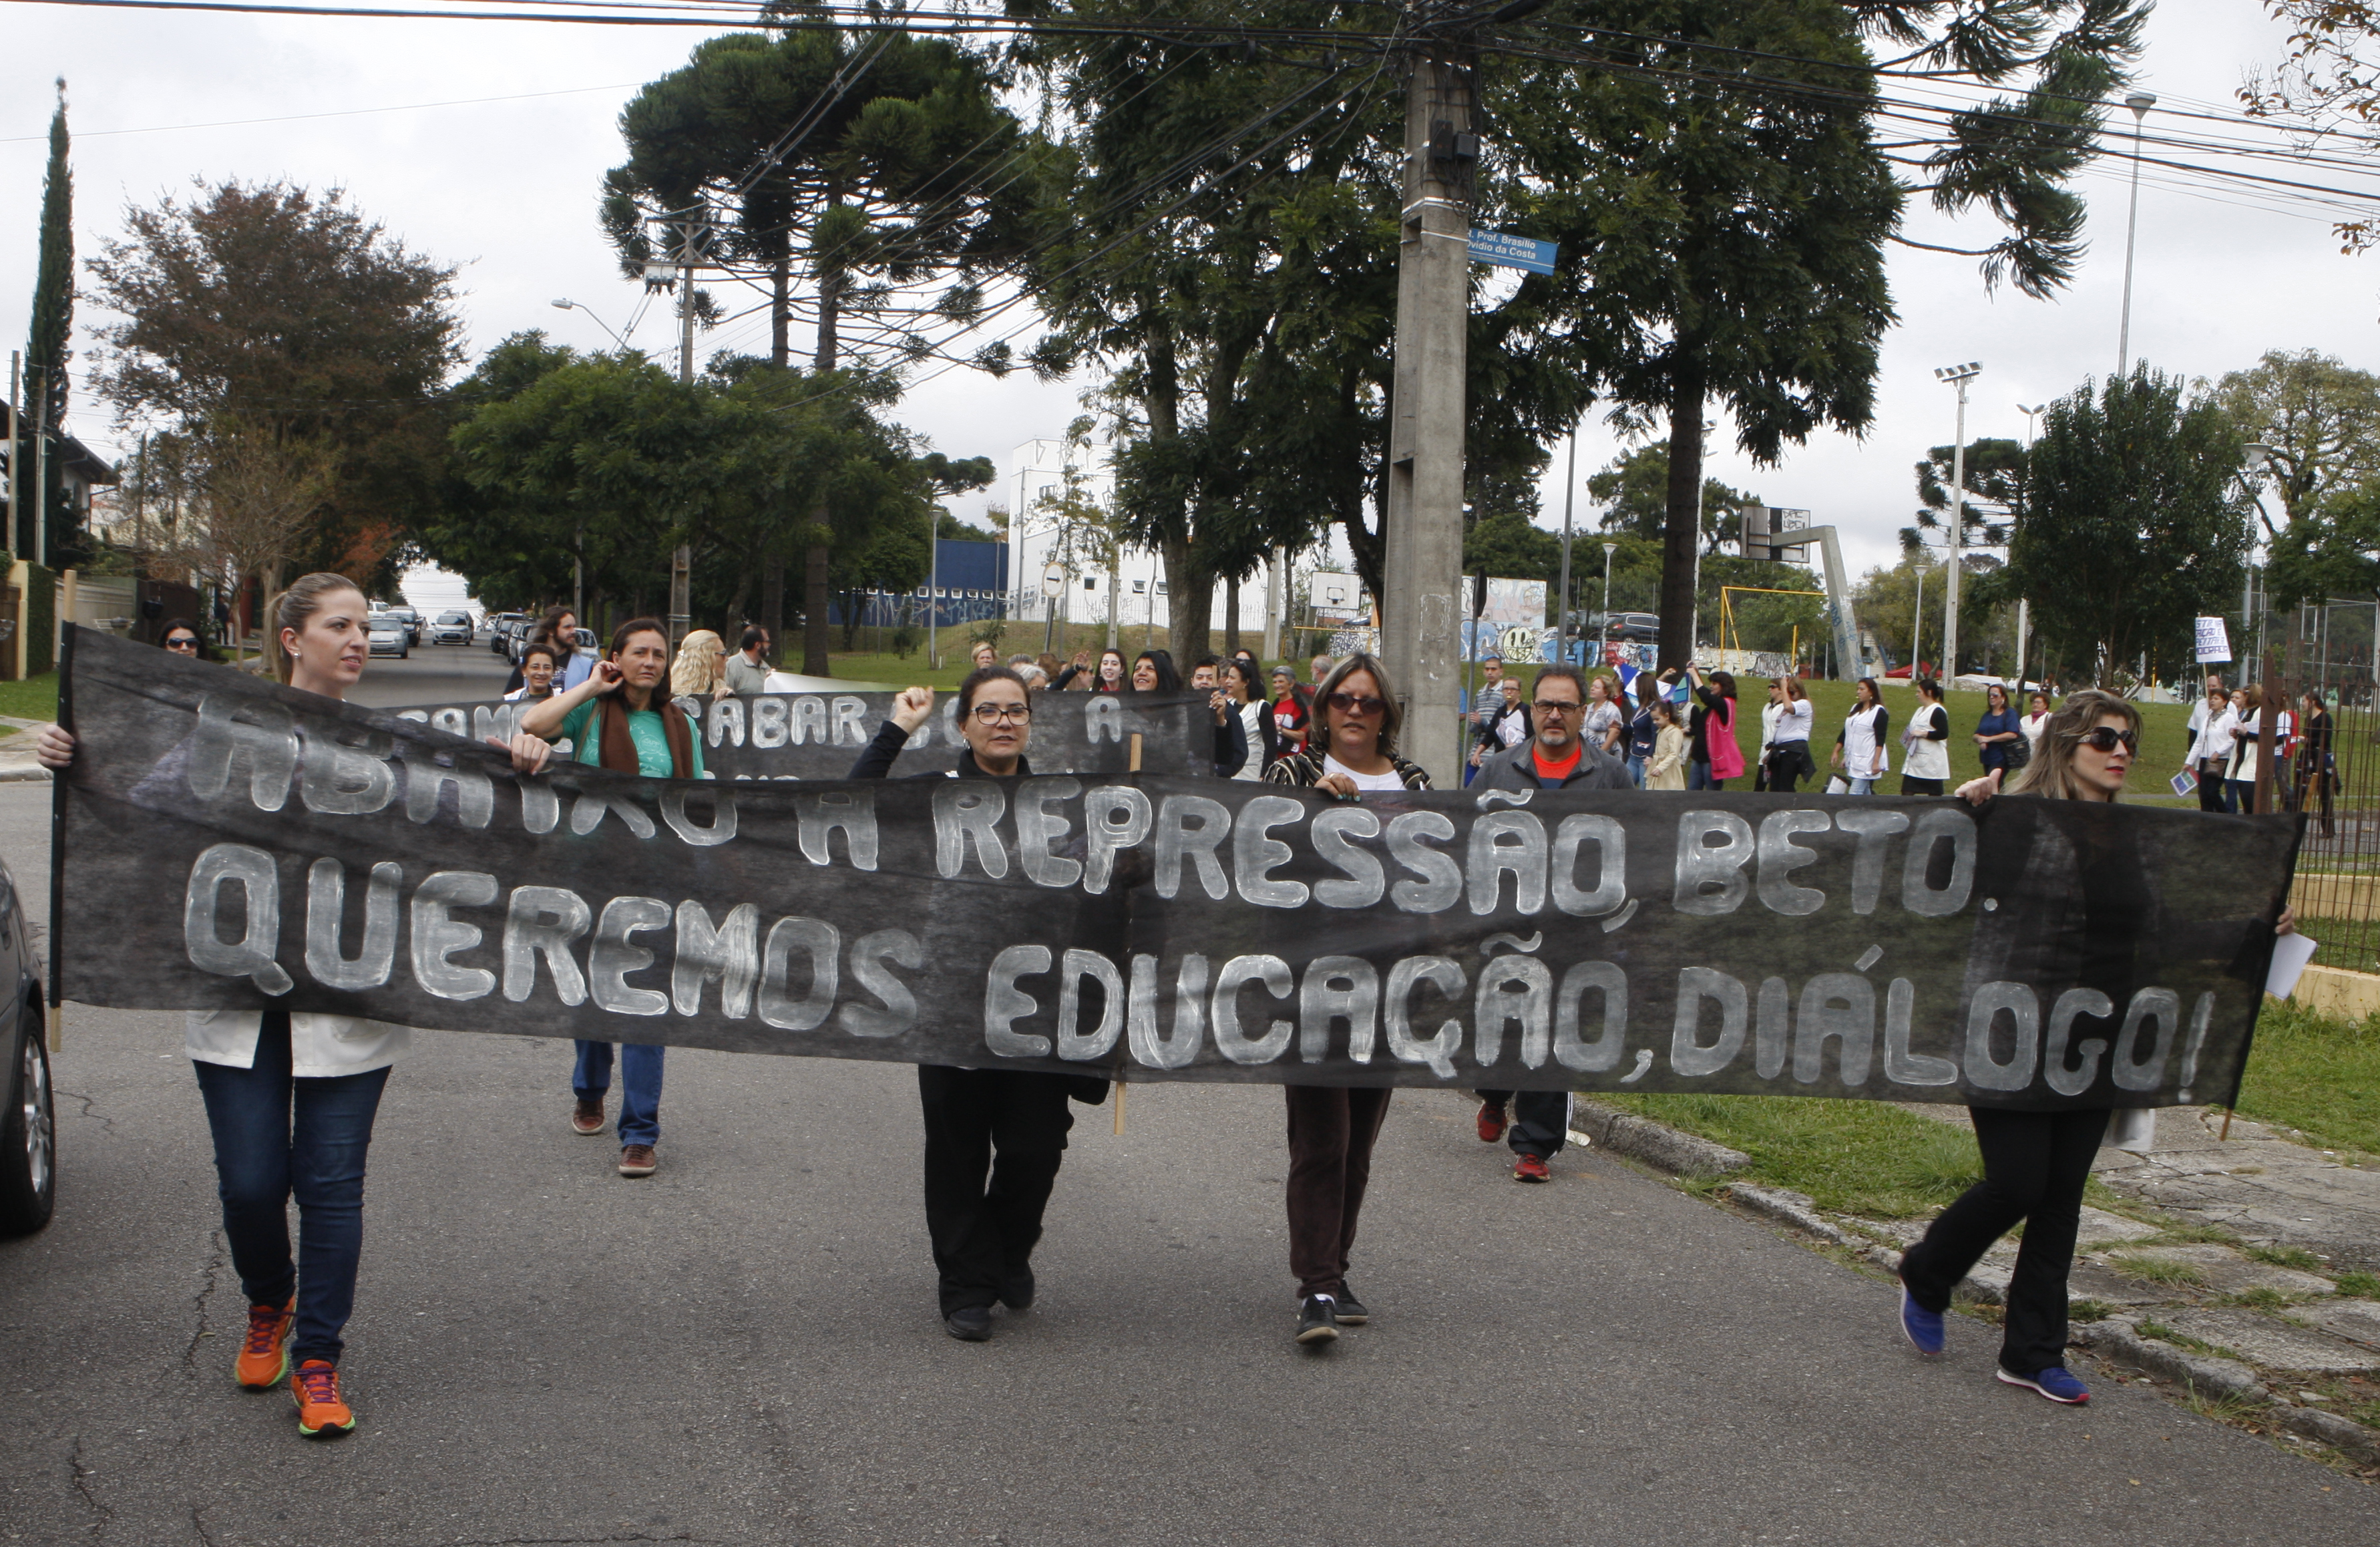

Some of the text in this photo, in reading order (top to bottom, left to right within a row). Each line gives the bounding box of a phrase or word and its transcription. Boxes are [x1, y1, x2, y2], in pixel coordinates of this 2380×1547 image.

[1477, 231, 1498, 242] Prof.
[1495, 244, 1507, 254] da
[1509, 247, 1536, 259] Costa
[1084, 695, 1123, 745] A
[797, 786, 879, 871] A
[932, 778, 1638, 933] REPRESSÃO,
[1672, 808, 1999, 918] BETO.
[184, 842, 2216, 1104] QUEREMOS EDUCAÇÃO, DIÁLOGO!
